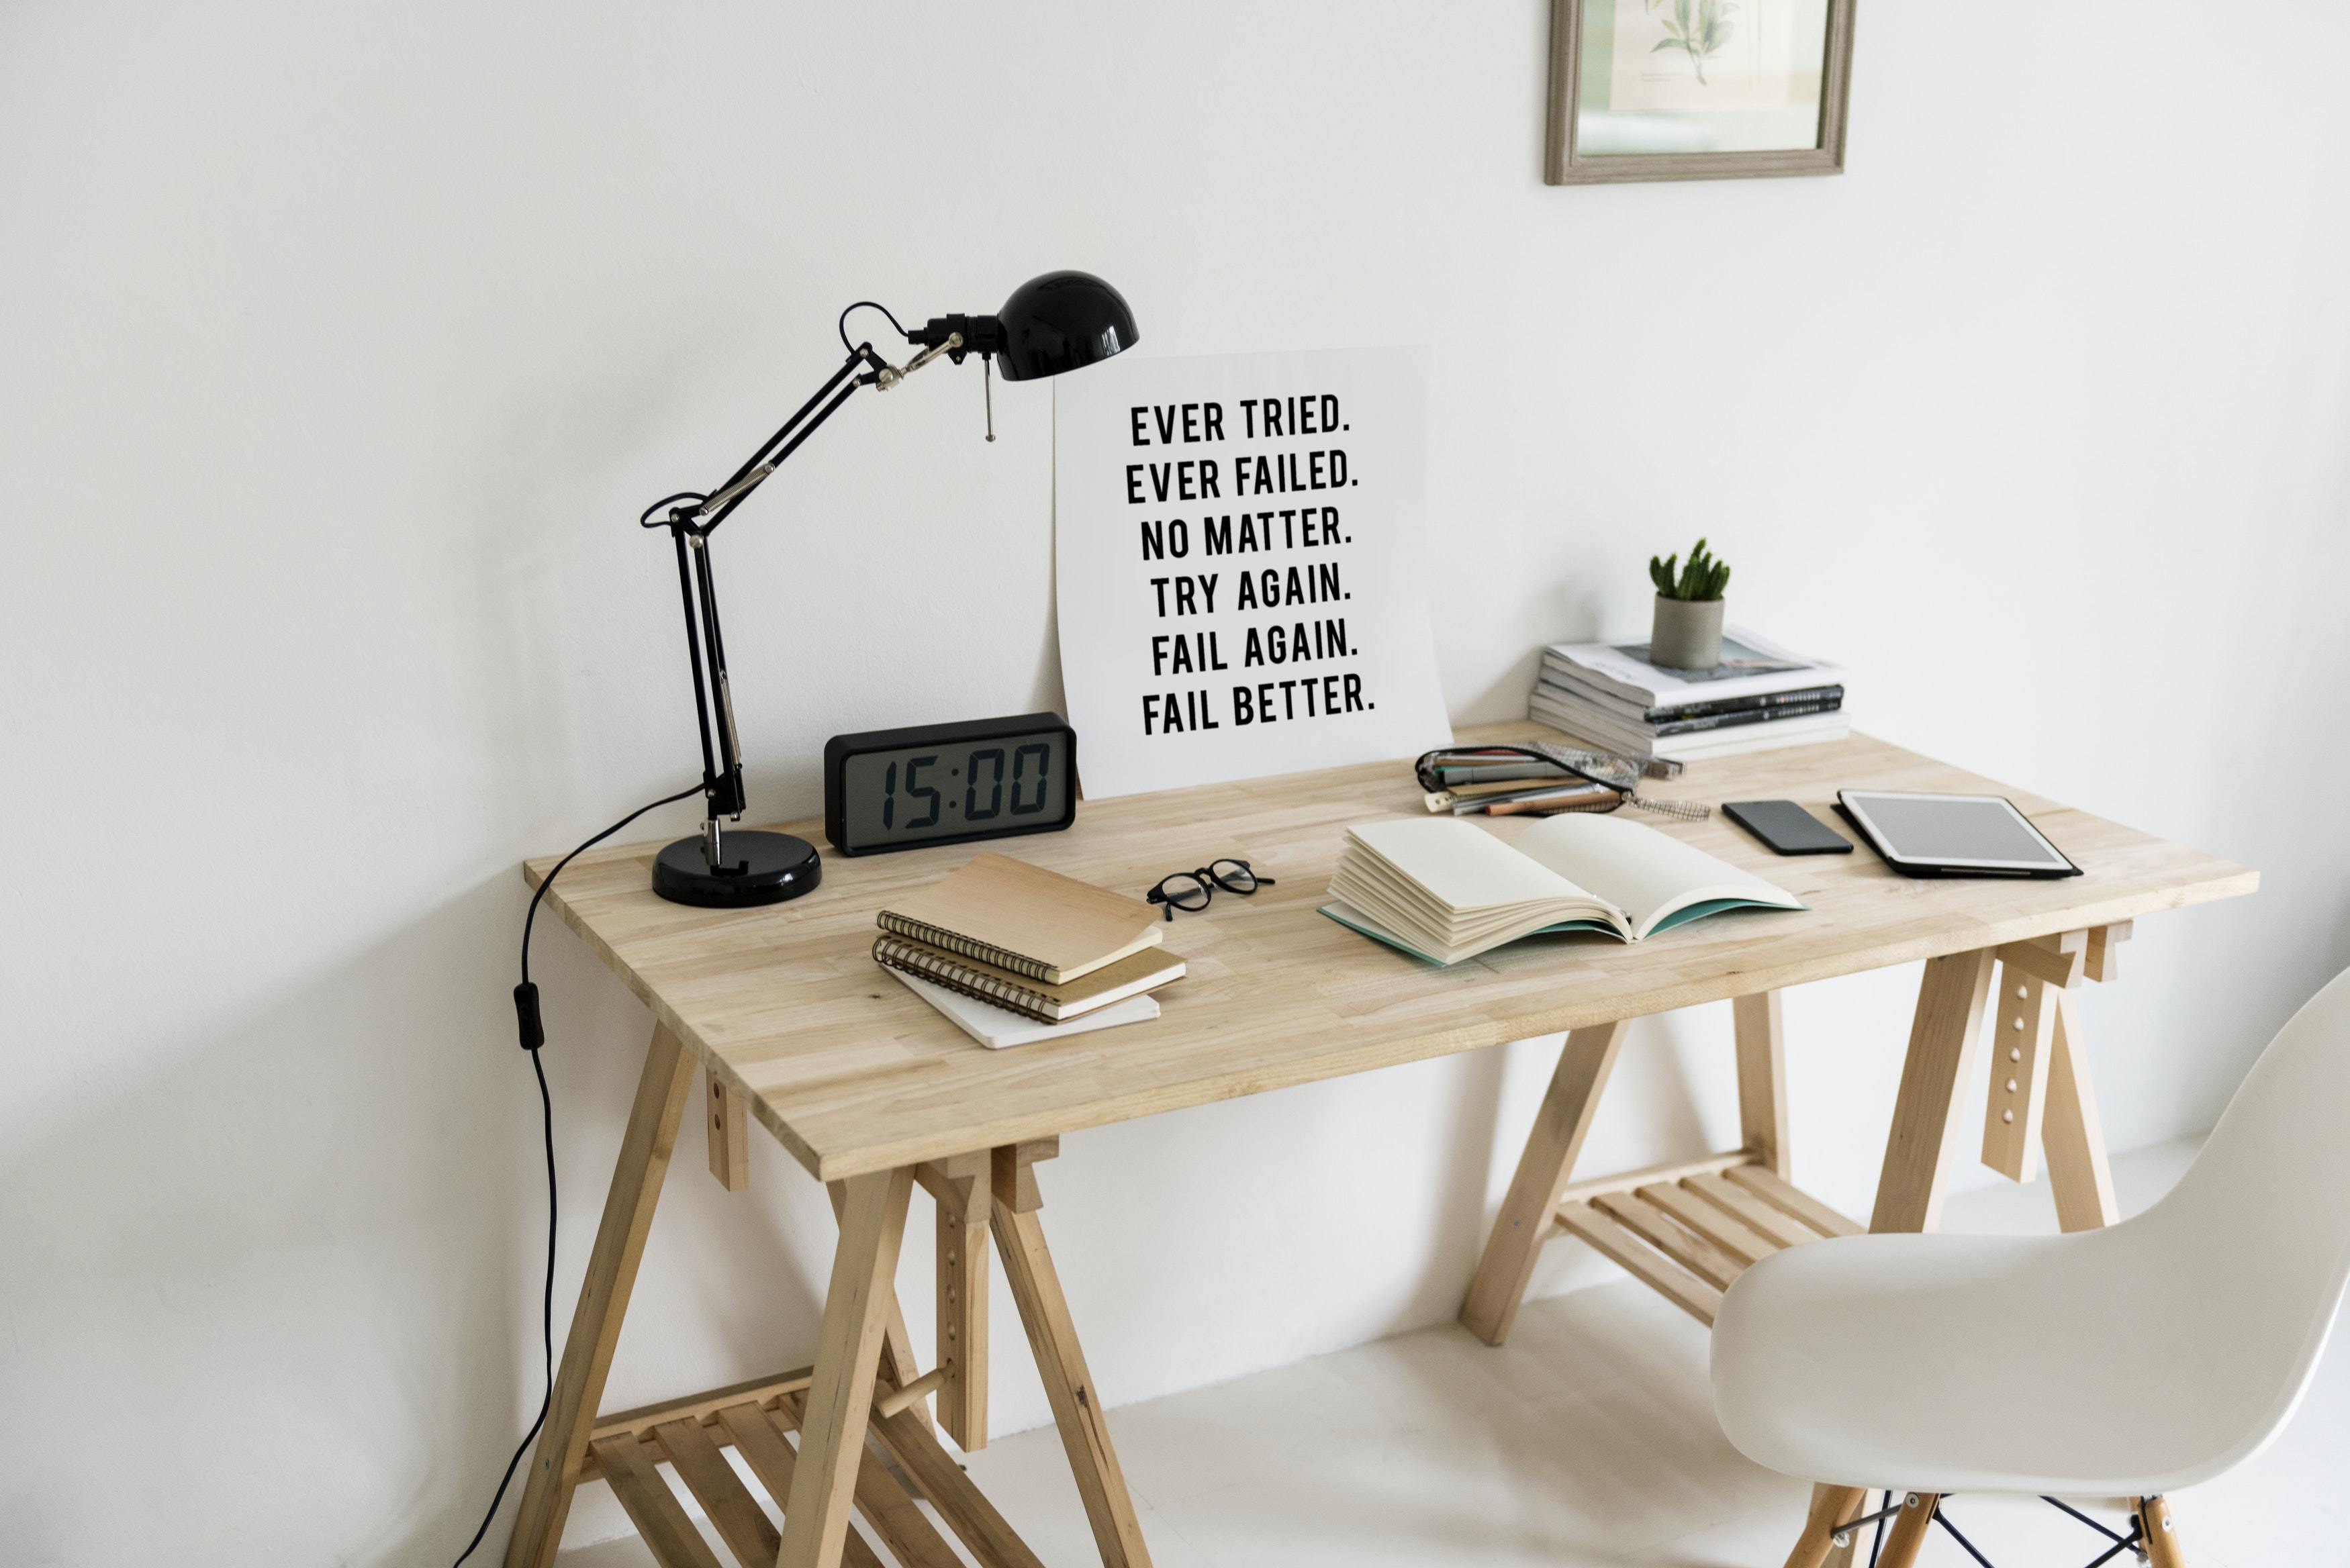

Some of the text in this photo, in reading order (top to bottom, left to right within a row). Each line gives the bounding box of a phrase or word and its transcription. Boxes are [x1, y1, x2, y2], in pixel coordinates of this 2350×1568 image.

[1131, 394, 1350, 446] EVER TRIED.
[1126, 449, 1358, 504] EVER FAILED.
[1141, 506, 1352, 561] NO MATTER.
[1150, 562, 1351, 618] TRY AGAIN.
[1152, 618, 1358, 676] FAIL AGAIN.
[1142, 673, 1374, 736] FAIL BETTER.
[883, 742, 1049, 830] 15:00
